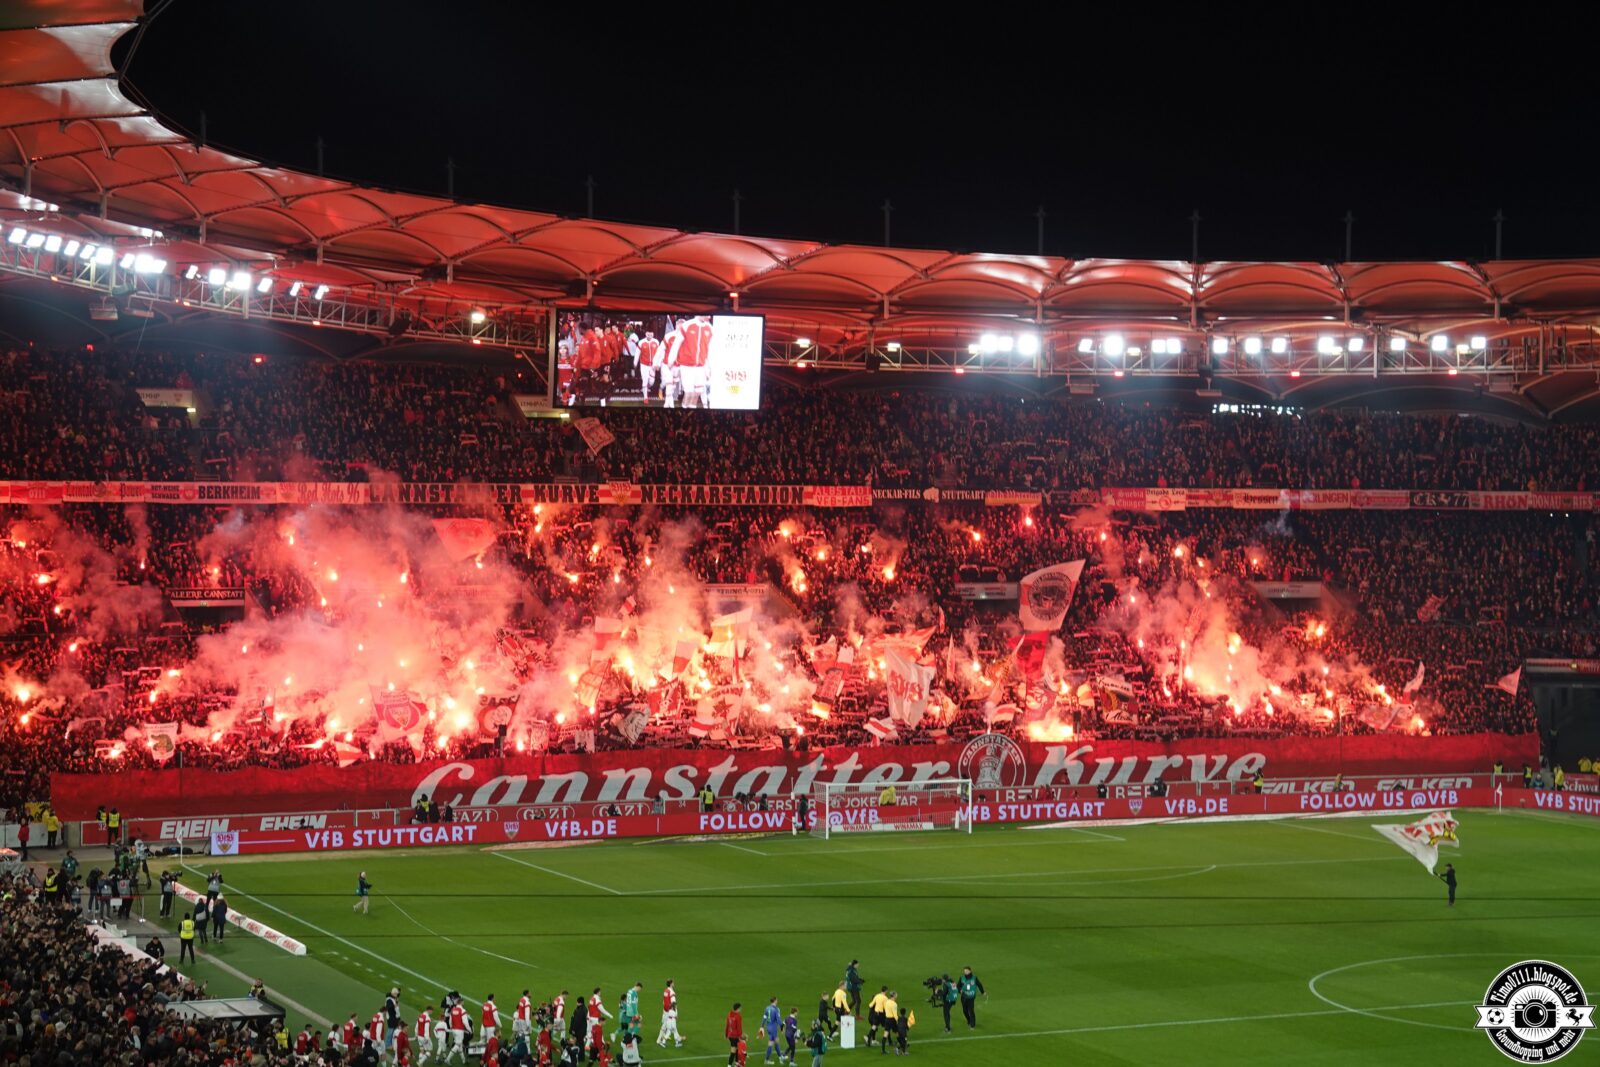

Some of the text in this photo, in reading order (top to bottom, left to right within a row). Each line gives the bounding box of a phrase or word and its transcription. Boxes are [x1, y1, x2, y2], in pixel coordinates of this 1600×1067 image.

[198, 486, 261, 499] BERKHEIM
[368, 484, 600, 502] CANNSTATER KURVE
[640, 485, 804, 504] NECKARSTADION
[815, 486, 871, 495] ALBSTADT
[941, 490, 985, 500] STUTTGART
[1303, 492, 1348, 503] RLINGEN
[1532, 494, 1562, 509] DONAU
[411, 751, 950, 808] Cannstatter
[1034, 744, 1267, 786] Kurve
[1376, 777, 1472, 791] FALKEN
[1260, 780, 1355, 795] FALKEN
[845, 795, 918, 808] JOKETAR
[1165, 797, 1229, 814] VfB.DE
[1301, 790, 1459, 809] FOLLOW US @VfB
[1535, 791, 1564, 808] VfB
[523, 806, 568, 820] GZI
[700, 812, 786, 830] FOLLOW
[829, 808, 880, 826] @VfB
[959, 801, 1105, 821] VfB STUTTGART
[160, 818, 230, 840] EHEIM
[260, 815, 328, 831] EHEIM
[545, 819, 617, 838] VfB.DE
[305, 825, 478, 849] VfB STUTTGART
